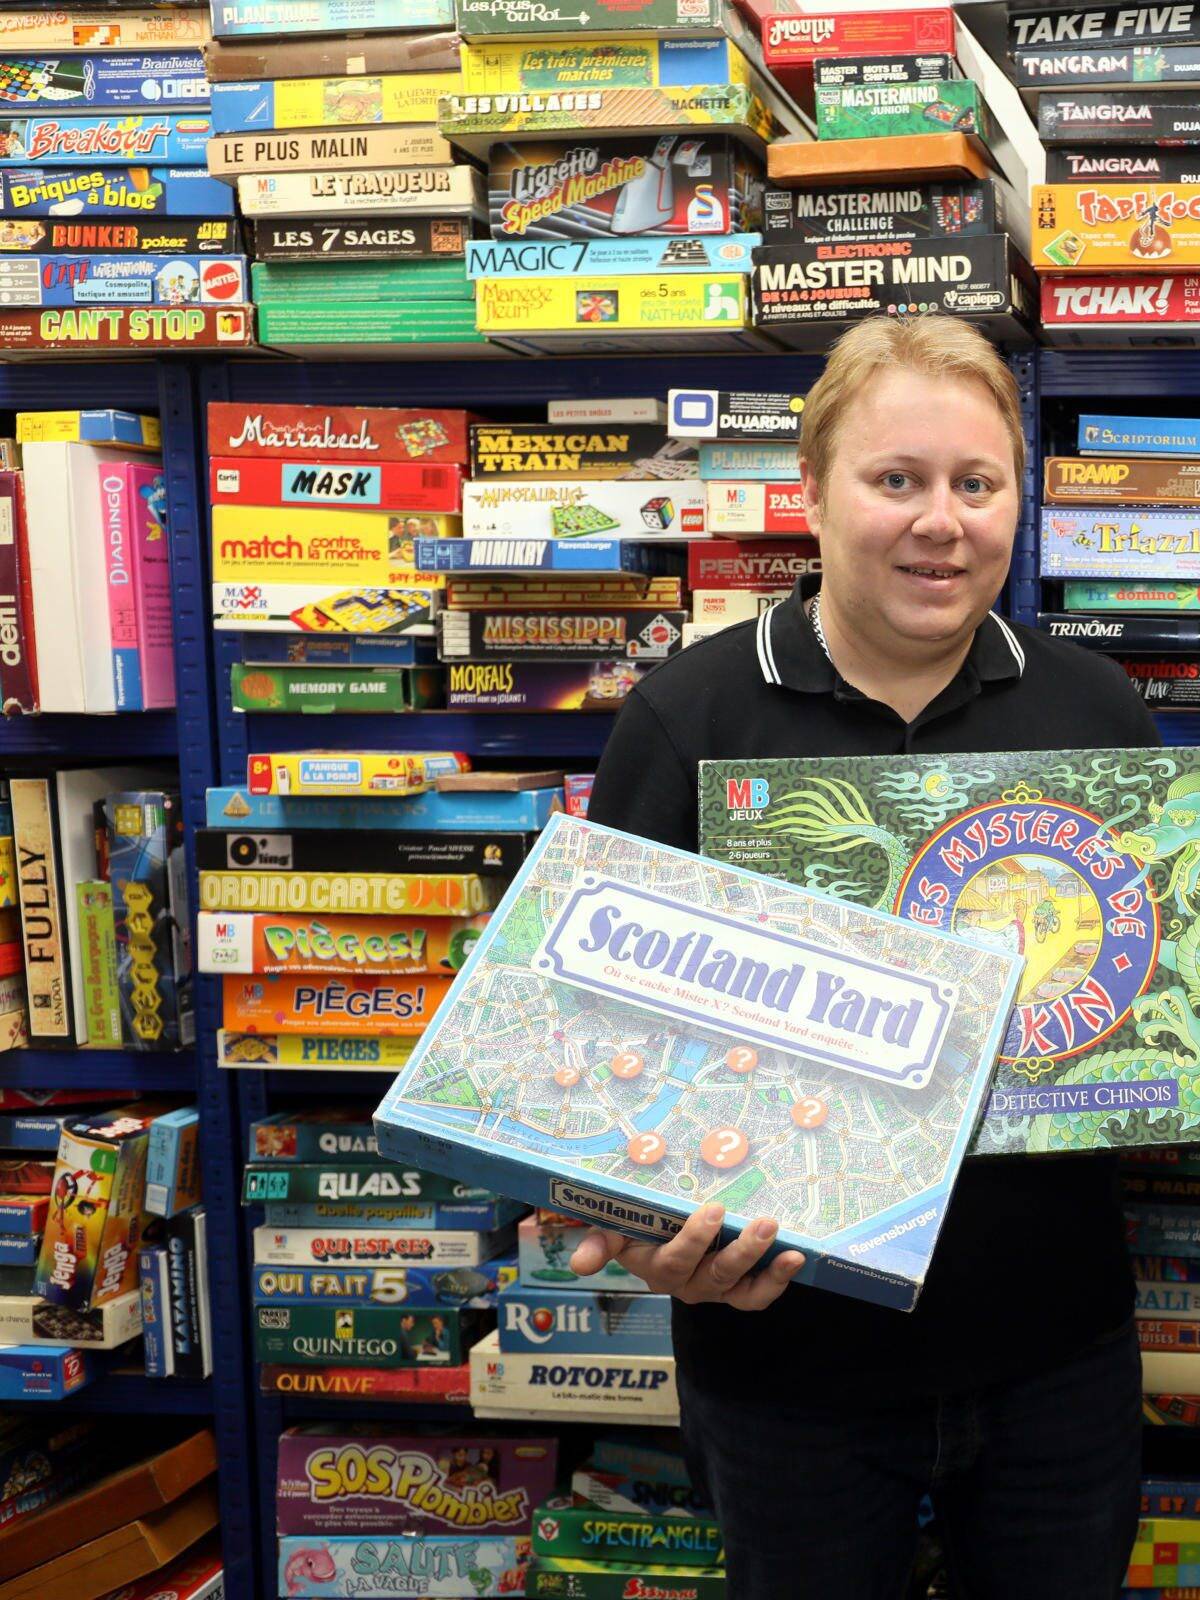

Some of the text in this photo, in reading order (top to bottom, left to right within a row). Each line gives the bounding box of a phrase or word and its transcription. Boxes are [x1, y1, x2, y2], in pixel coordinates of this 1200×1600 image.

[1013, 4, 1195, 45] TAKE FIVE
[820, 66, 857, 75] MASTER
[1022, 56, 1128, 75] TANGRAM
[842, 86, 939, 107] MASTERMIND
[871, 105, 909, 115] JUNIOR
[27, 123, 171, 159] Breakout
[223, 137, 368, 164] LE PLUS MALIN
[512, 148, 598, 200] Ligretto
[1066, 155, 1161, 174] TANGRAM
[88, 184, 156, 210] à bloc
[310, 170, 450, 197] LE TRAQUEUR
[502, 155, 648, 235] Speed Machine
[798, 191, 923, 217] MASTERMIND
[53, 225, 138, 247] BUNKER
[827, 216, 894, 232] CHALLENGE
[272, 227, 416, 251] LES 7 SAGES
[817, 242, 912, 259] ELECTRONIC
[469, 241, 590, 273] MAGIC 7
[760, 256, 972, 291] MASTER MIND
[1053, 279, 1174, 316] TCHAK!
[40, 310, 205, 340] CAN'T STOP
[229, 415, 379, 450] Marrakech
[720, 414, 797, 430] DUJARDIN
[476, 434, 629, 453] MEXICAN
[1102, 428, 1197, 446] SCRIPTORIUM
[478, 454, 581, 471] TRAIN
[1057, 463, 1129, 484] TRAMP
[291, 469, 372, 497] MASK
[681, 514, 702, 526] LEGO
[221, 535, 302, 560] match
[308, 546, 380, 560] la montre
[310, 537, 360, 548] contre
[470, 541, 547, 566] MIMIKRY
[483, 617, 627, 644] MISSISSIPPI
[1050, 621, 1124, 637] TRINÔME
[289, 682, 387, 693] MEMORY GAME
[450, 663, 514, 692] MORFALS
[727, 778, 770, 809] MB
[730, 810, 762, 820] JEUX
[741, 851, 770, 861] joueurs
[757, 839, 772, 847] plus
[910, 877, 949, 926] ES
[939, 809, 1125, 880] MYSTERES
[1107, 887, 1148, 939] DE
[19, 847, 54, 964] FULLY
[204, 875, 406, 909] ORDINO CARTE
[263, 921, 427, 964] Pièges!
[579, 905, 924, 1049] Scotland Yard
[295, 980, 424, 1017] PIÈGES!
[603, 964, 621, 978] Où
[624, 971, 636, 982] se
[638, 976, 672, 994] cache
[673, 986, 711, 1006] Mister
[731, 1004, 782, 1029] Scotland
[782, 1019, 809, 1039] Yard
[302, 1038, 380, 1061] PIEGES
[993, 1085, 1171, 1111] DETECTIVE CHINOIS
[562, 1188, 686, 1234] Scotland Ya
[848, 1205, 939, 1257] Ravensburger
[49, 1241, 77, 1290] Jenga
[826, 1258, 911, 1289] Ravensburger
[259, 1269, 408, 1304] QUI FAIT 5
[505, 1302, 591, 1344] Rolit
[292, 1336, 398, 1357] QUINTEGO
[529, 1363, 669, 1391] ROTOFLIP
[396, 1449, 530, 1528] Plombier
[581, 1520, 718, 1552] SPECTRANGLE
